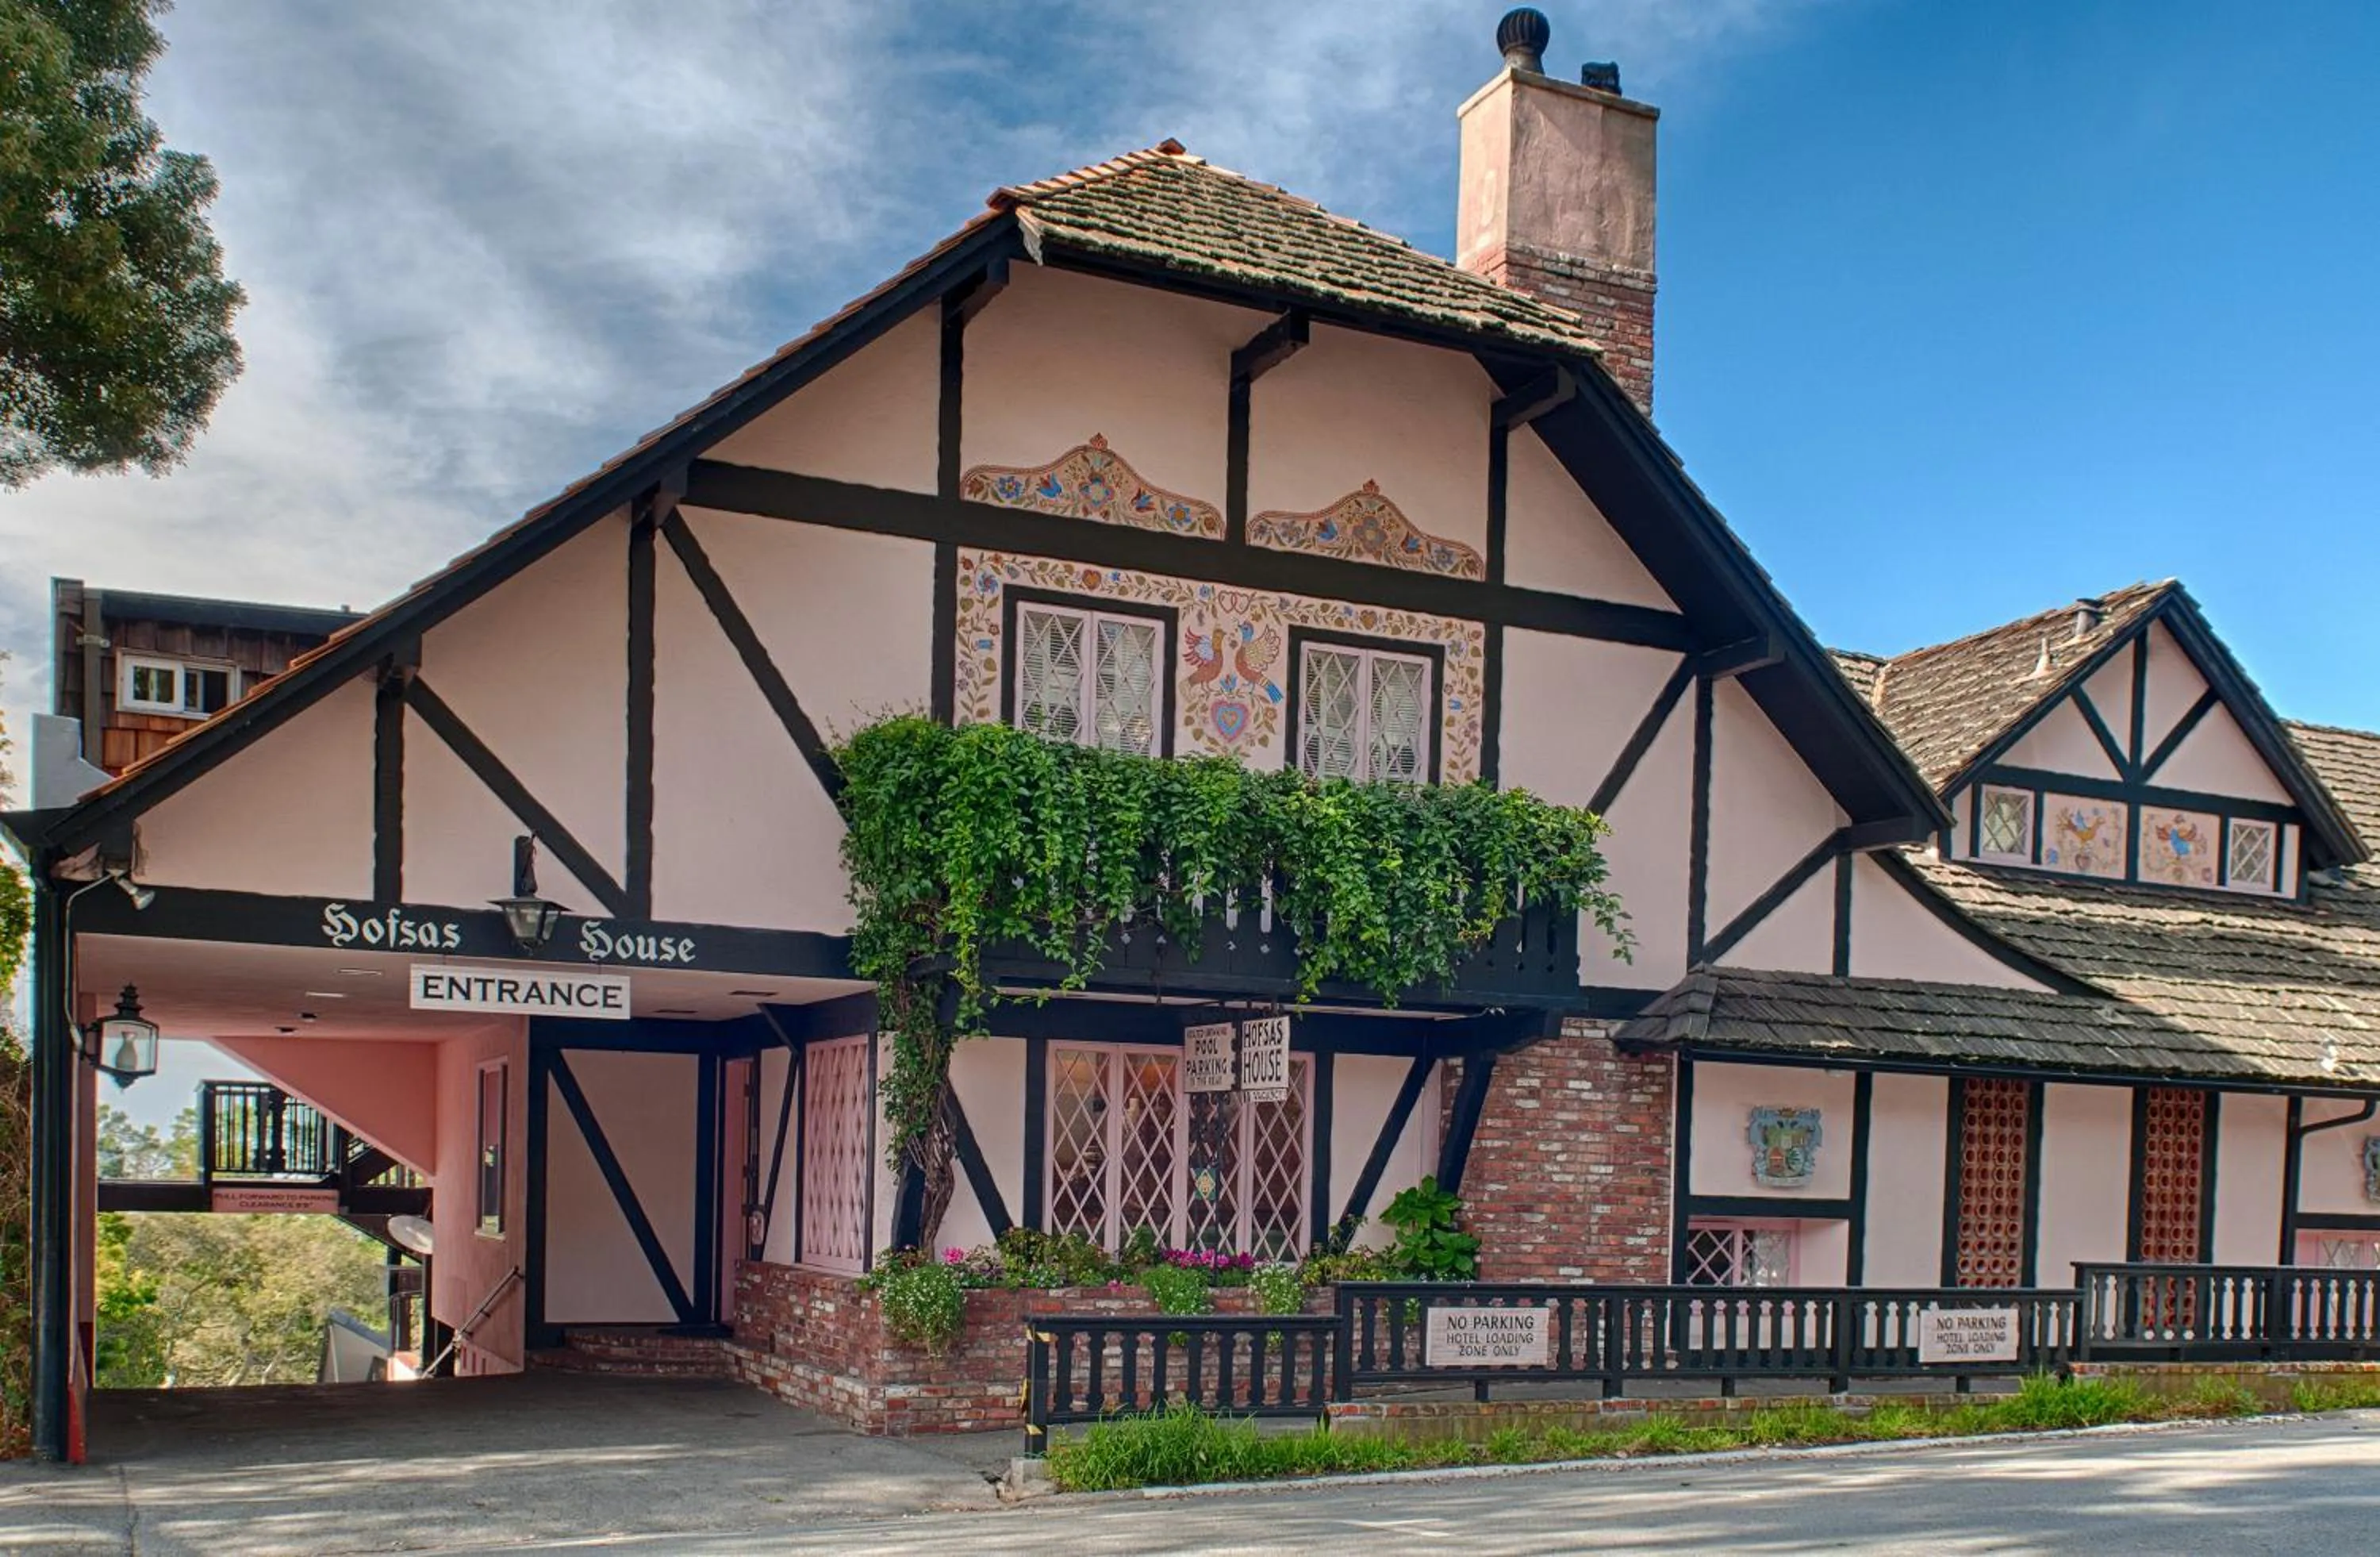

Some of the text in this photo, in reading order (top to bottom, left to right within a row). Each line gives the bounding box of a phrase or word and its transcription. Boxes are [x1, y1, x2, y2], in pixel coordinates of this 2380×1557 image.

[321, 902, 697, 963] Hofsas House
[422, 975, 624, 1009] ENTRANCE
[1243, 1021, 1283, 1048] HOFSAS
[1196, 1037, 1218, 1055] POOL
[1186, 1057, 1227, 1076] PARKING
[1243, 1049, 1281, 1083] HOUSE
[1447, 1316, 1534, 1330] NO PARKING
[1937, 1316, 2006, 1330] NO PARKING
[1446, 1332, 1534, 1344] HOTEL LOADING
[1937, 1331, 2006, 1344] HOTEL LOADING
[1459, 1345, 1521, 1356] ZONE ONLY
